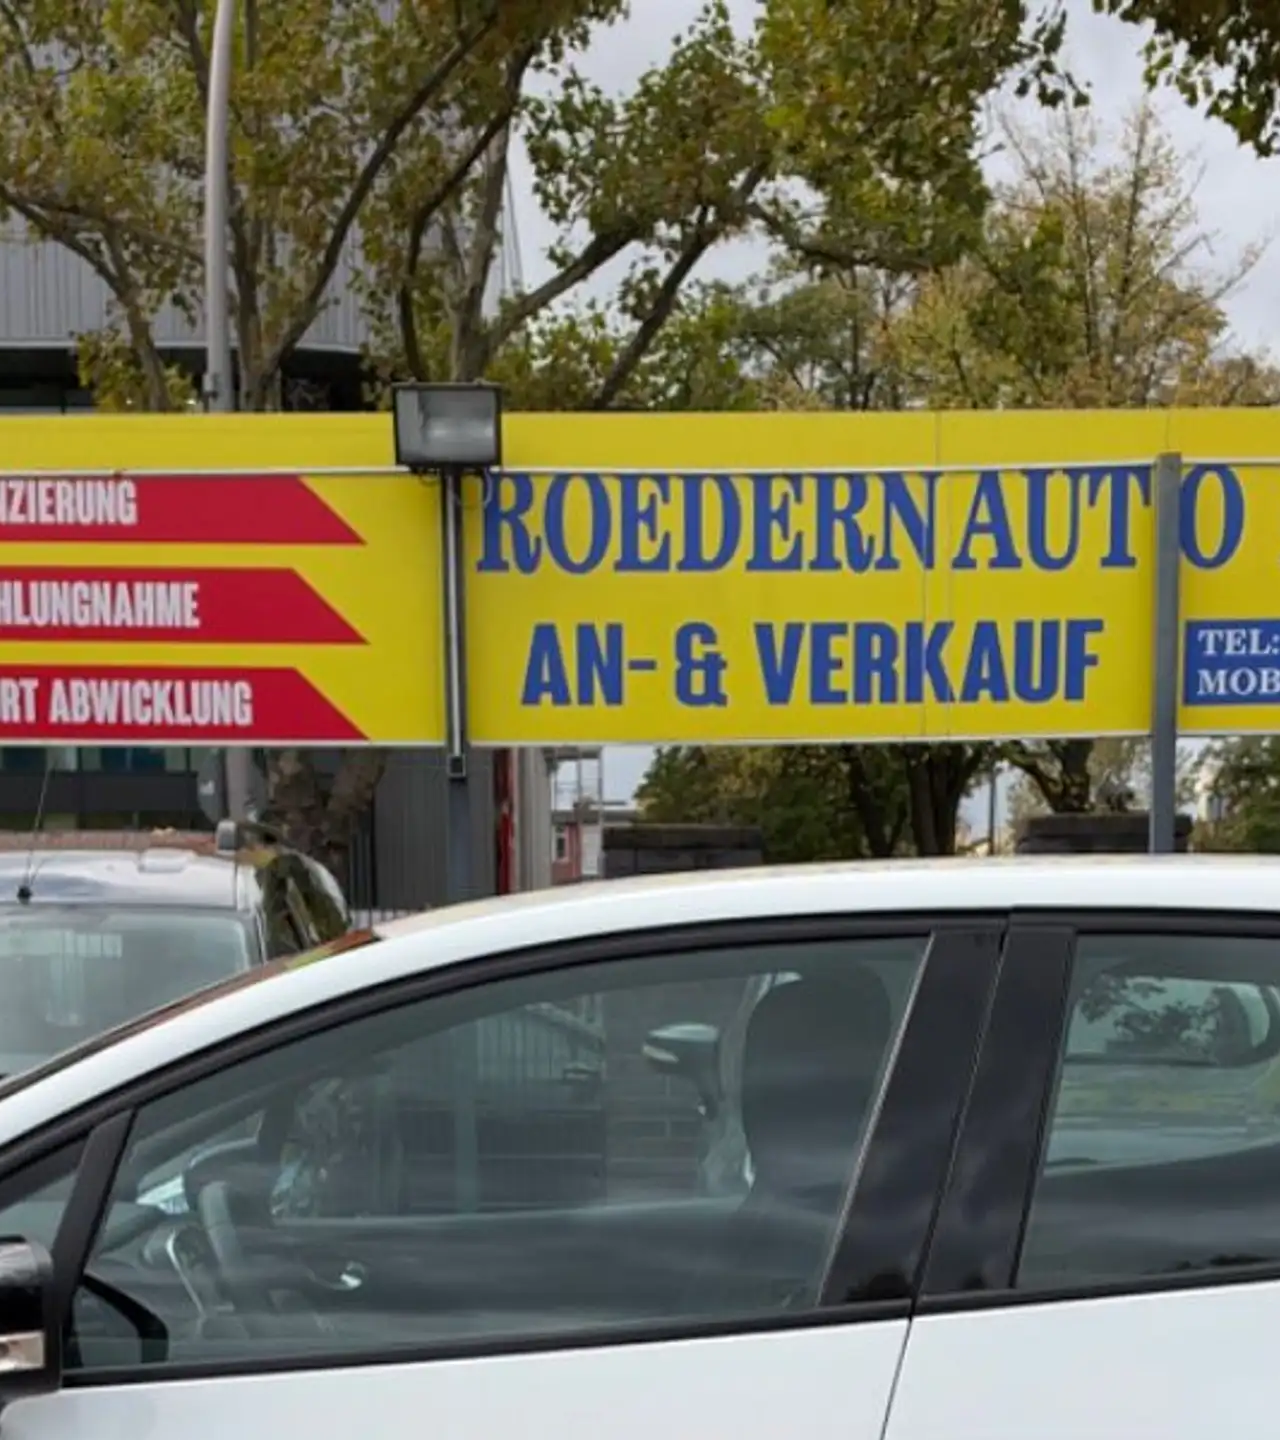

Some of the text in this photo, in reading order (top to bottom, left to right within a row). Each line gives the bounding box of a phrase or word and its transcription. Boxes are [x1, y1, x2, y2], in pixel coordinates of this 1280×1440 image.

[521, 619, 1104, 707] AN- & VERKAUF
[1197, 628, 1280, 656] TEL:
[49, 681, 253, 726] ABWICKLUNG
